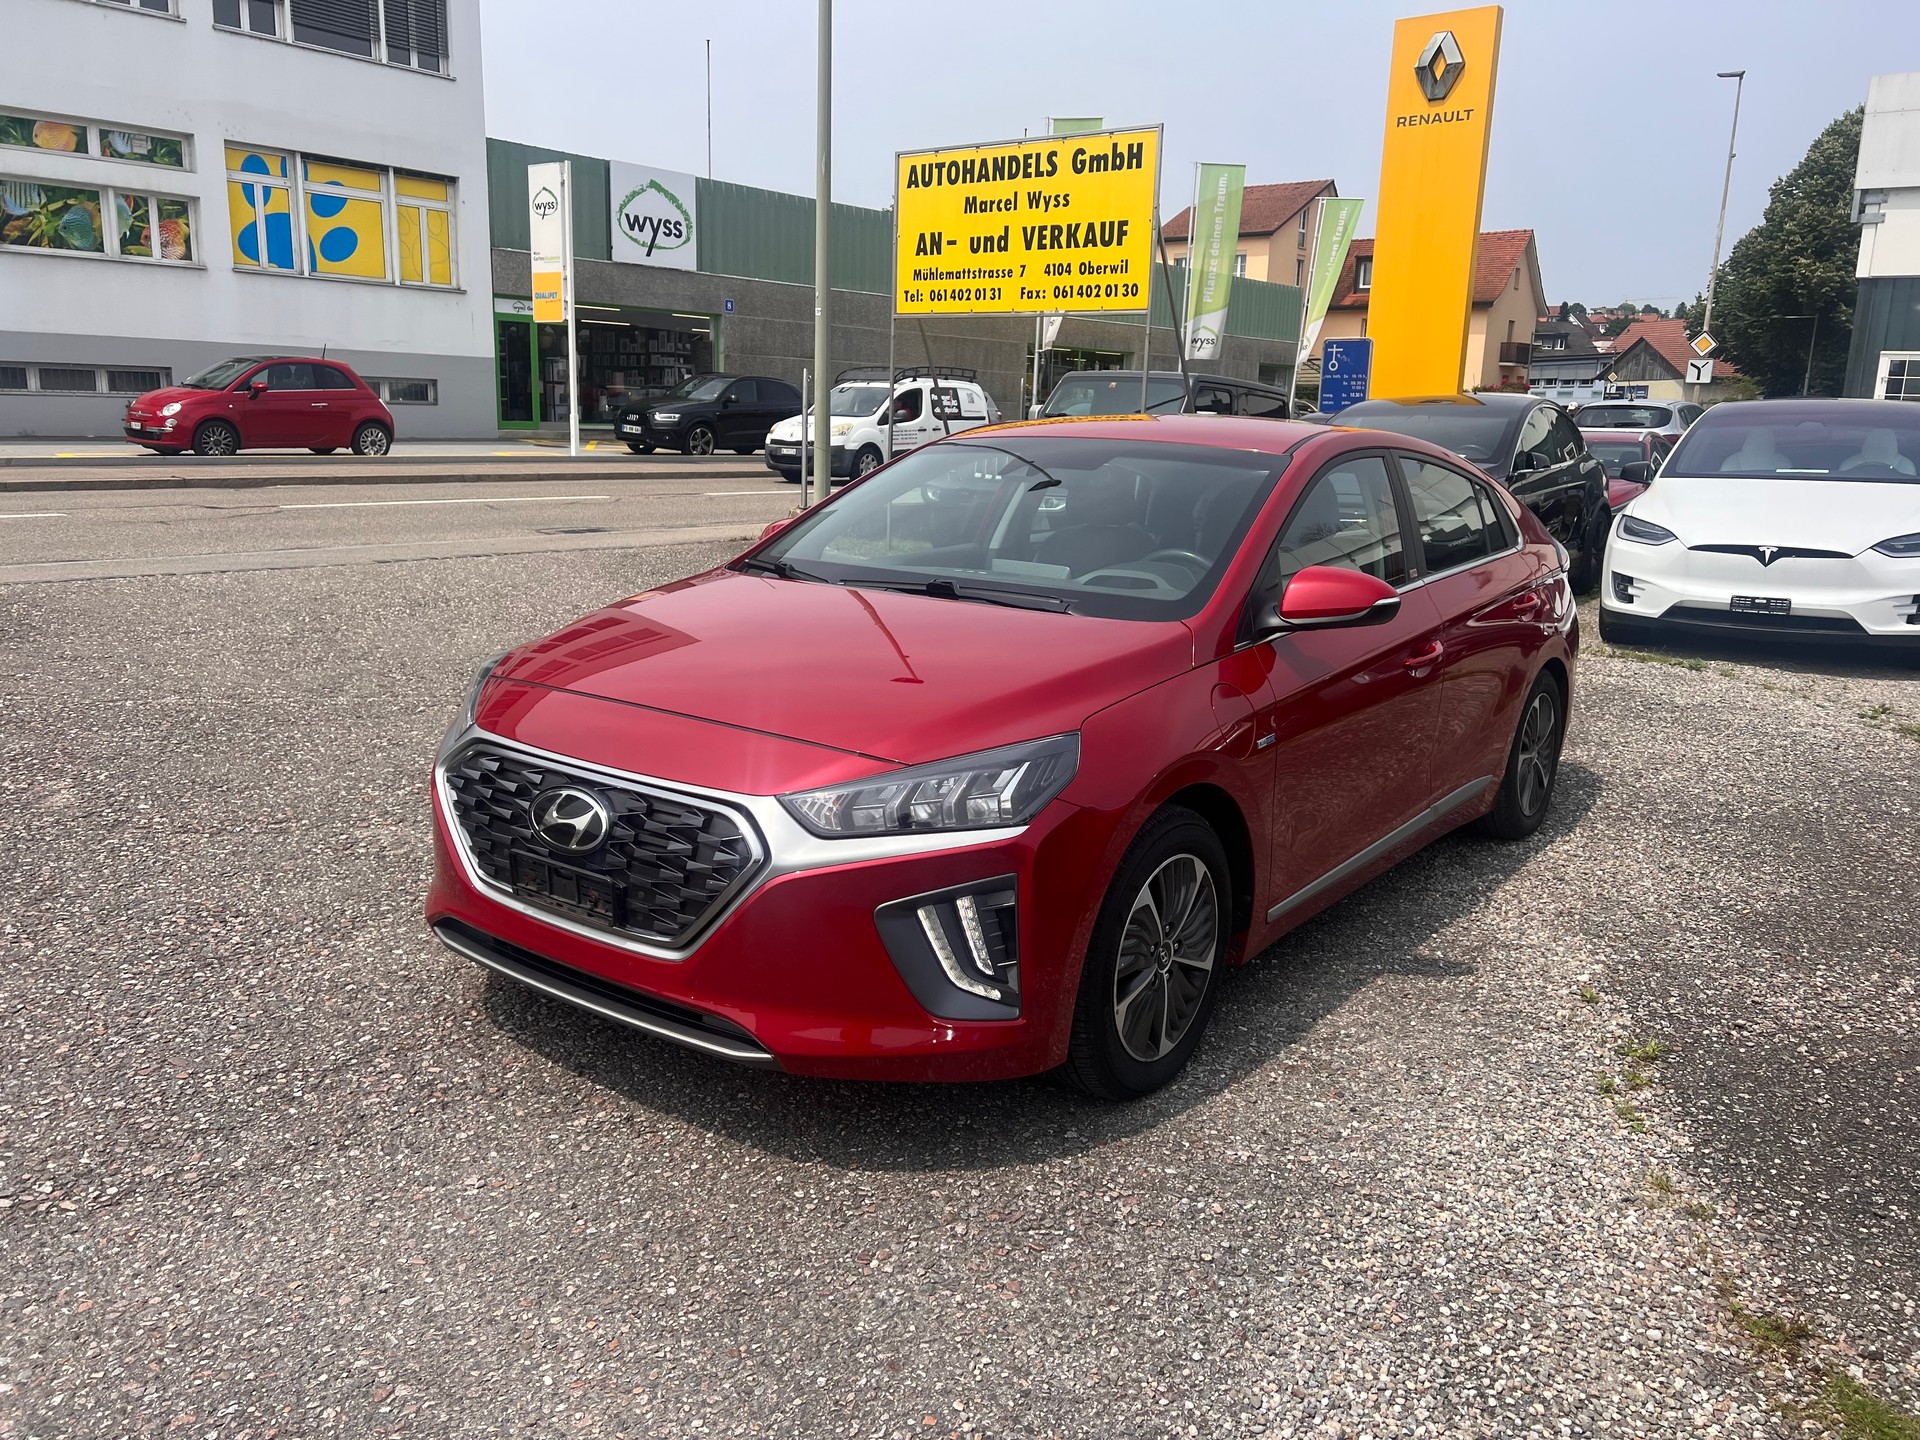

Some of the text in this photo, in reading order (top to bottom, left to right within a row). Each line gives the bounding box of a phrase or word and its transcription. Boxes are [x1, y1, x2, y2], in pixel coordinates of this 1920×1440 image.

[1396, 108, 1475, 128] RENAULT
[906, 142, 1144, 189] AUTOHANDELS GmbH
[535, 201, 555, 220] wyss
[963, 190, 1070, 214] Marcel Wyss
[624, 212, 683, 258] wyss
[969, 225, 1009, 254] und
[1022, 219, 1129, 251] VERKAUF
[1332, 207, 1348, 244] Traum.
[1203, 173, 1228, 303] Pflanze deinen Traum.
[913, 259, 1129, 281] Mühlemattstrasse 7 4104 Oberwil
[904, 288, 923, 302] Tel:
[1020, 286, 1046, 300] Fax:
[1191, 335, 1215, 352] wyss
